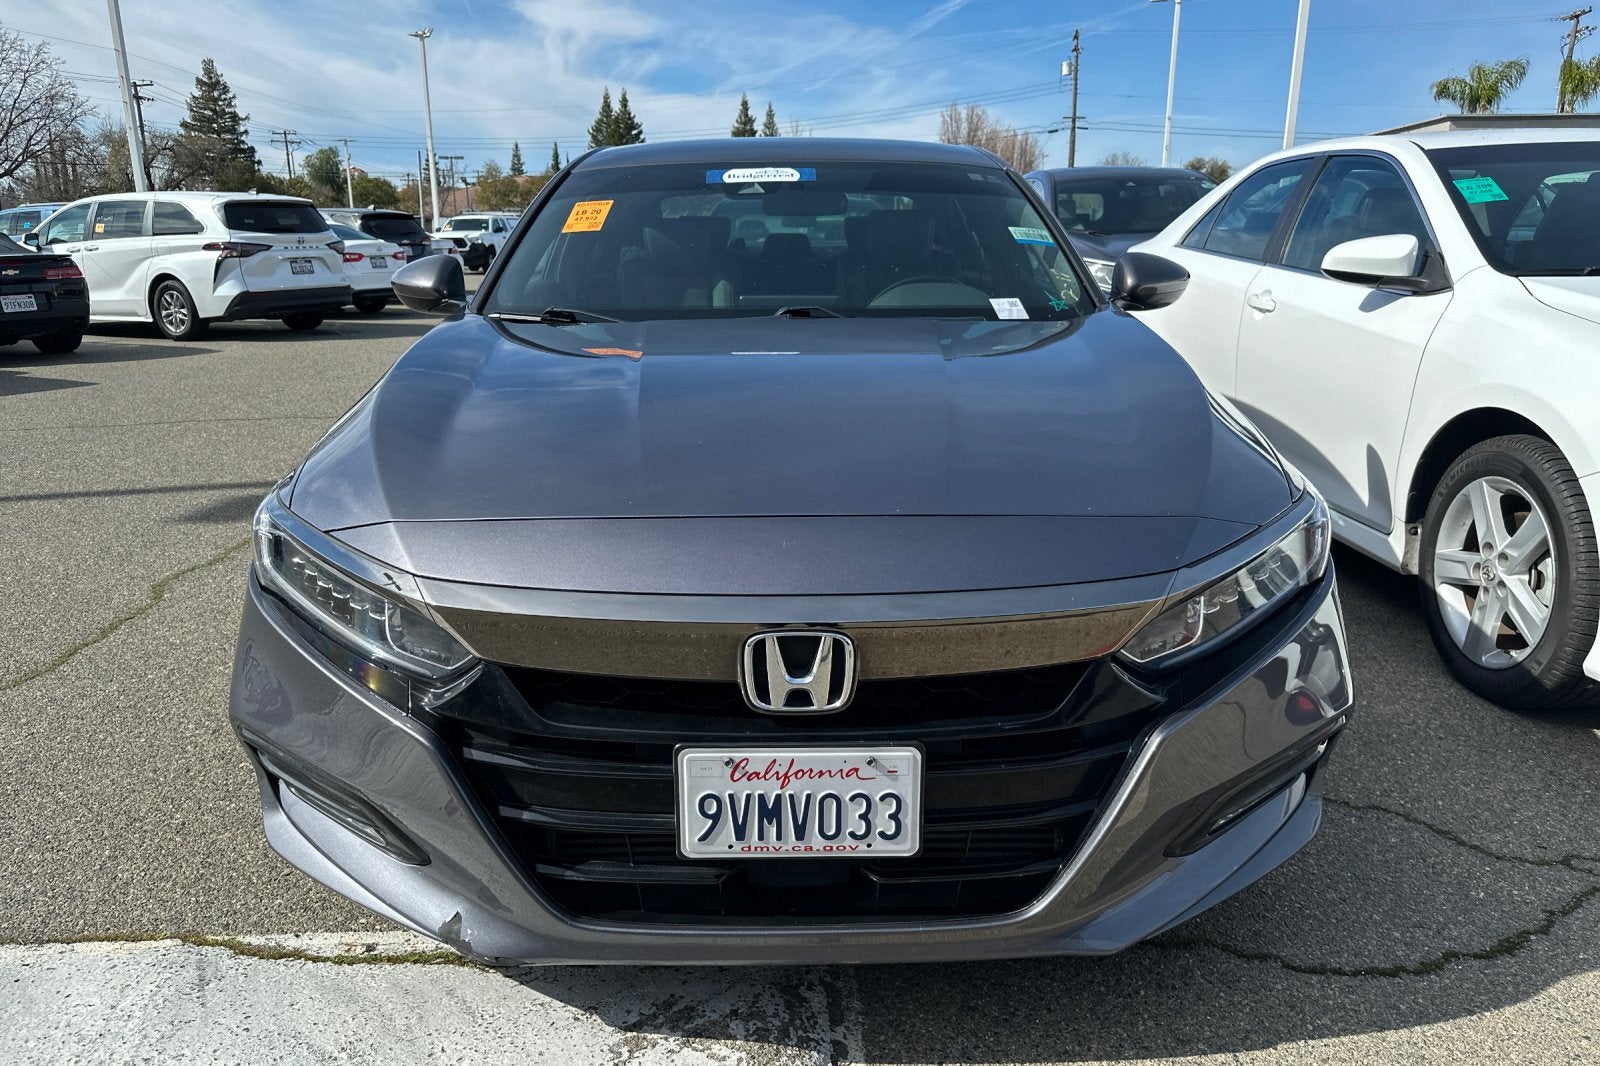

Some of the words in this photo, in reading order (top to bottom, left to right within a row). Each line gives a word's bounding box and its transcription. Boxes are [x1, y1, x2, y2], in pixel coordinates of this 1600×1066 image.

[730, 757, 876, 790] California
[697, 792, 903, 842] 9VMV033
[740, 844, 860, 853] dmv.ca.gov
